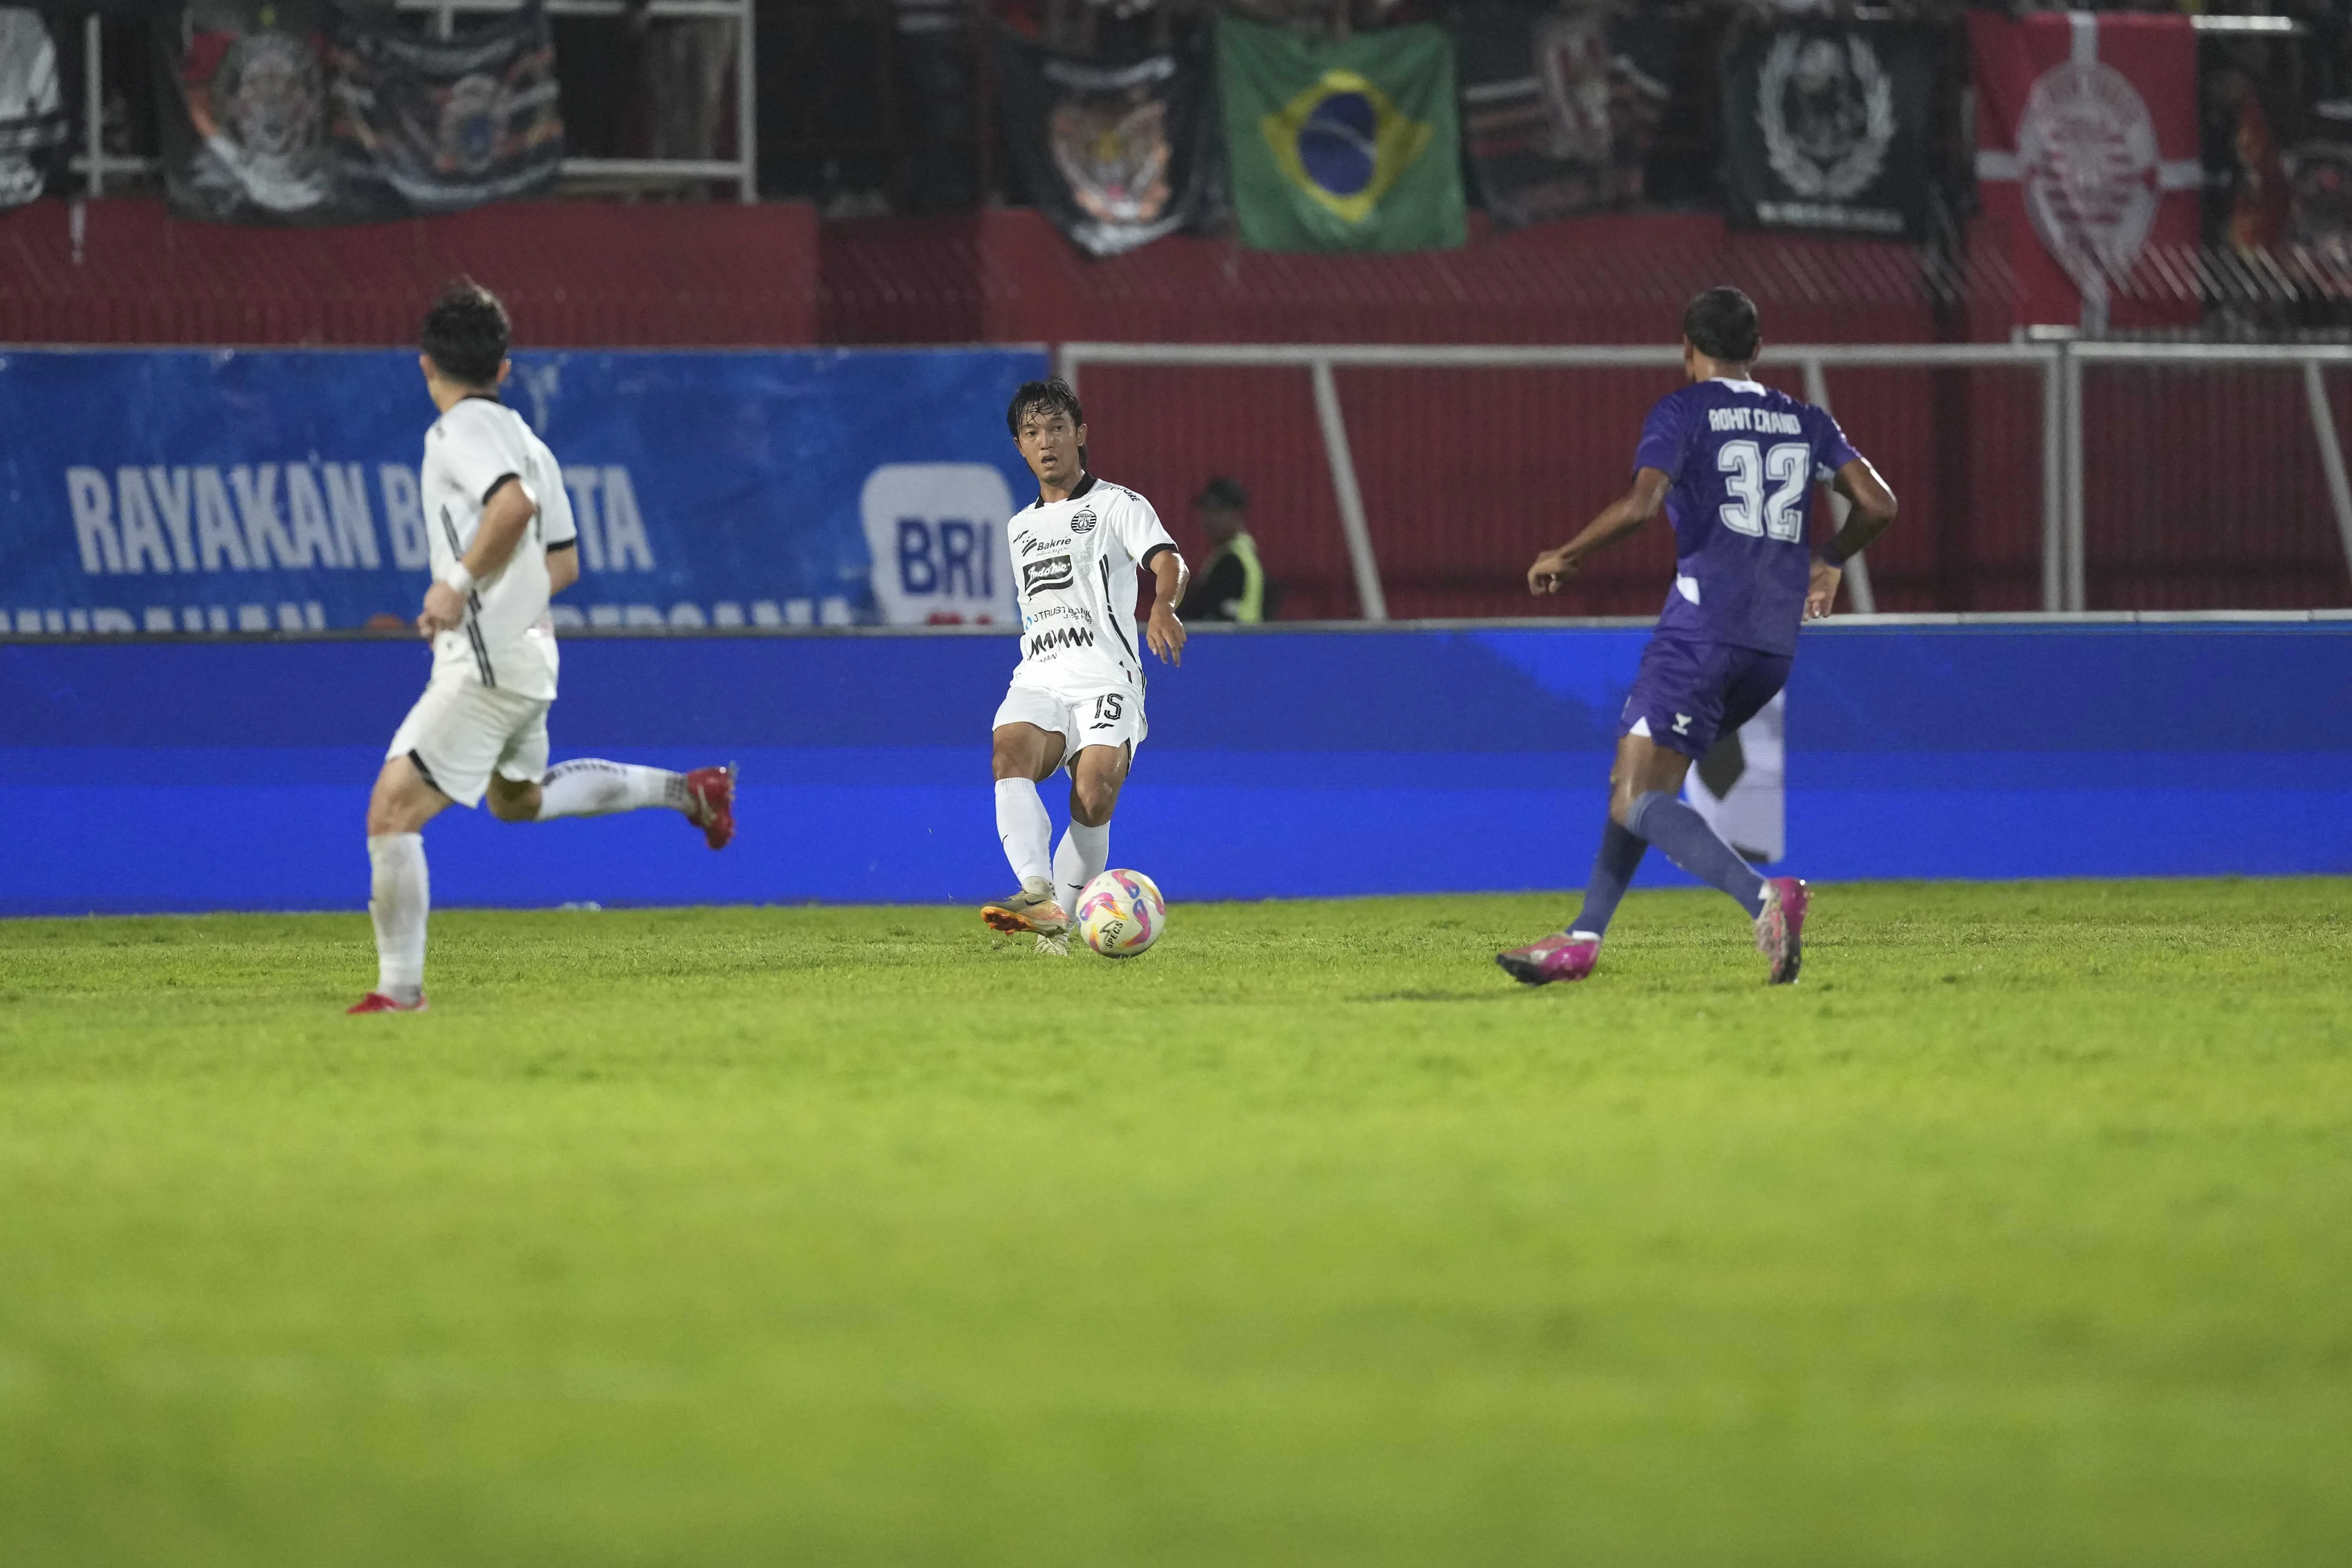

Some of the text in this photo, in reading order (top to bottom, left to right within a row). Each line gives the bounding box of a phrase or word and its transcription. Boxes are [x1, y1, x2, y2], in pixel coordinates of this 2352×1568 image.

[66, 461, 382, 575] RAYAKAN
[1717, 439, 1810, 544] 32
[896, 517, 993, 599] BRI
[1037, 537, 1071, 551] Bakrie
[1094, 693, 1124, 720] 15
[1105, 920, 1123, 948] SPECS
